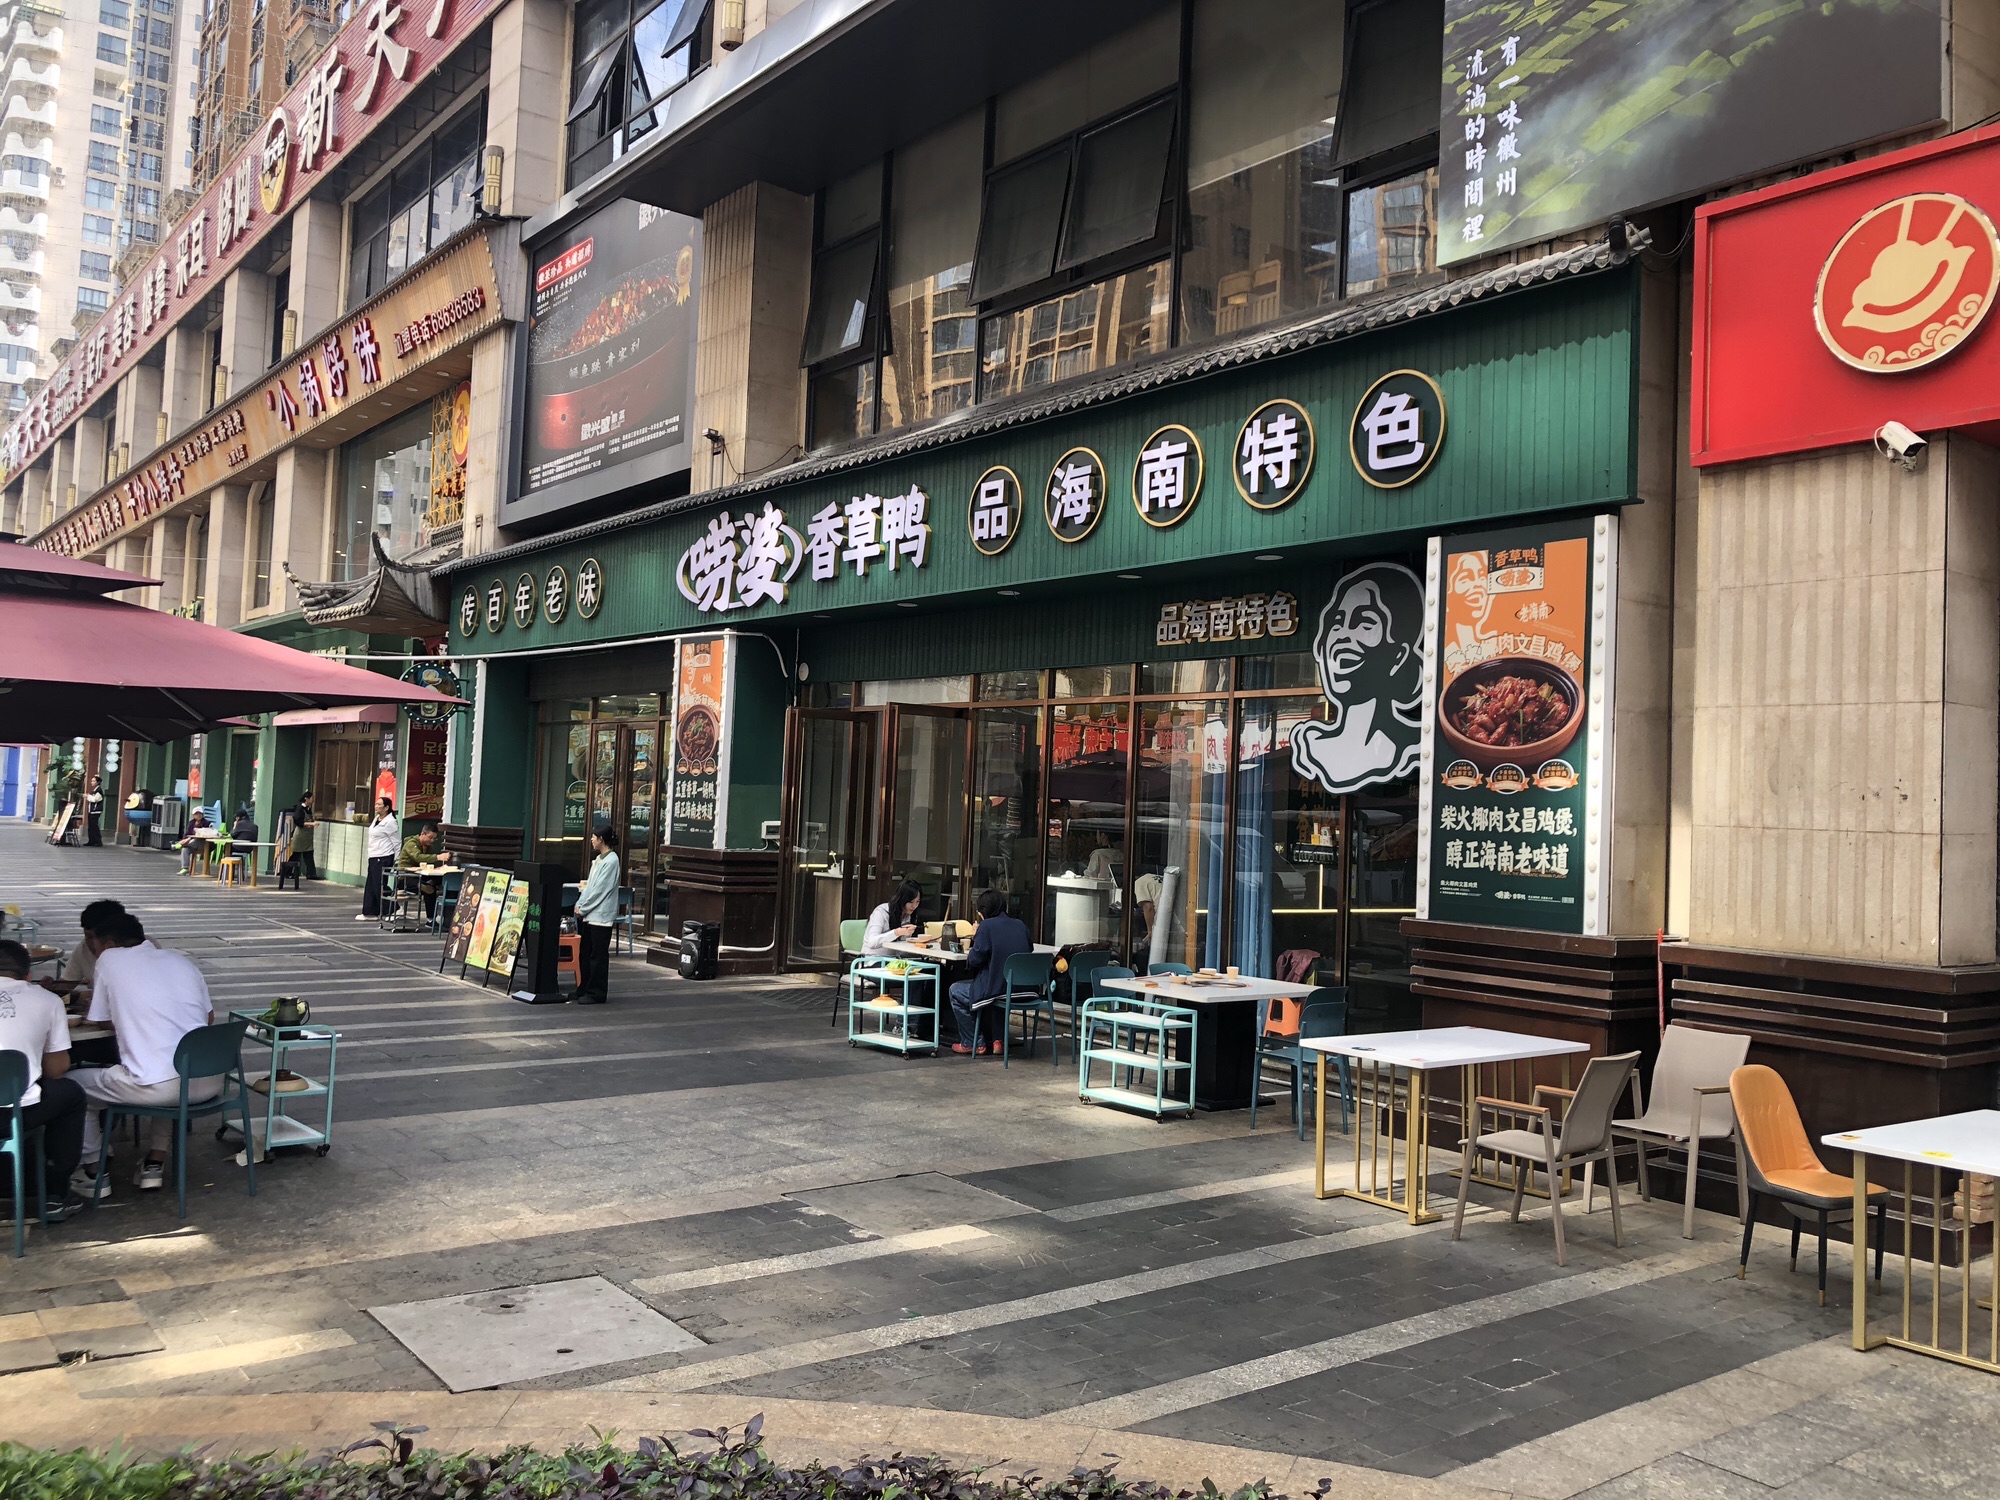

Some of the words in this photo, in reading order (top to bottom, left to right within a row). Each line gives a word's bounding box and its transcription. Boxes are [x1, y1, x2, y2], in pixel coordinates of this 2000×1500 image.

[1497, 35, 1523, 197] 有一味徽州
[1462, 48, 1488, 243] 流淌的時間裡
[638, 203, 671, 231] 徽兴
[973, 391, 1426, 541] 品海南特色
[689, 500, 787, 613] 唠婆
[804, 484, 928, 582] 香草鸭
[1494, 547, 1538, 568] 香草鸭
[460, 557, 597, 627] 传百年老味
[1156, 592, 1293, 643] 品海南特色
[1519, 600, 1549, 623] 老海南
[1440, 805, 1577, 837] 柴火椰肉文昌鸡煲,
[1446, 839, 1569, 875] 醇正海南老味道
